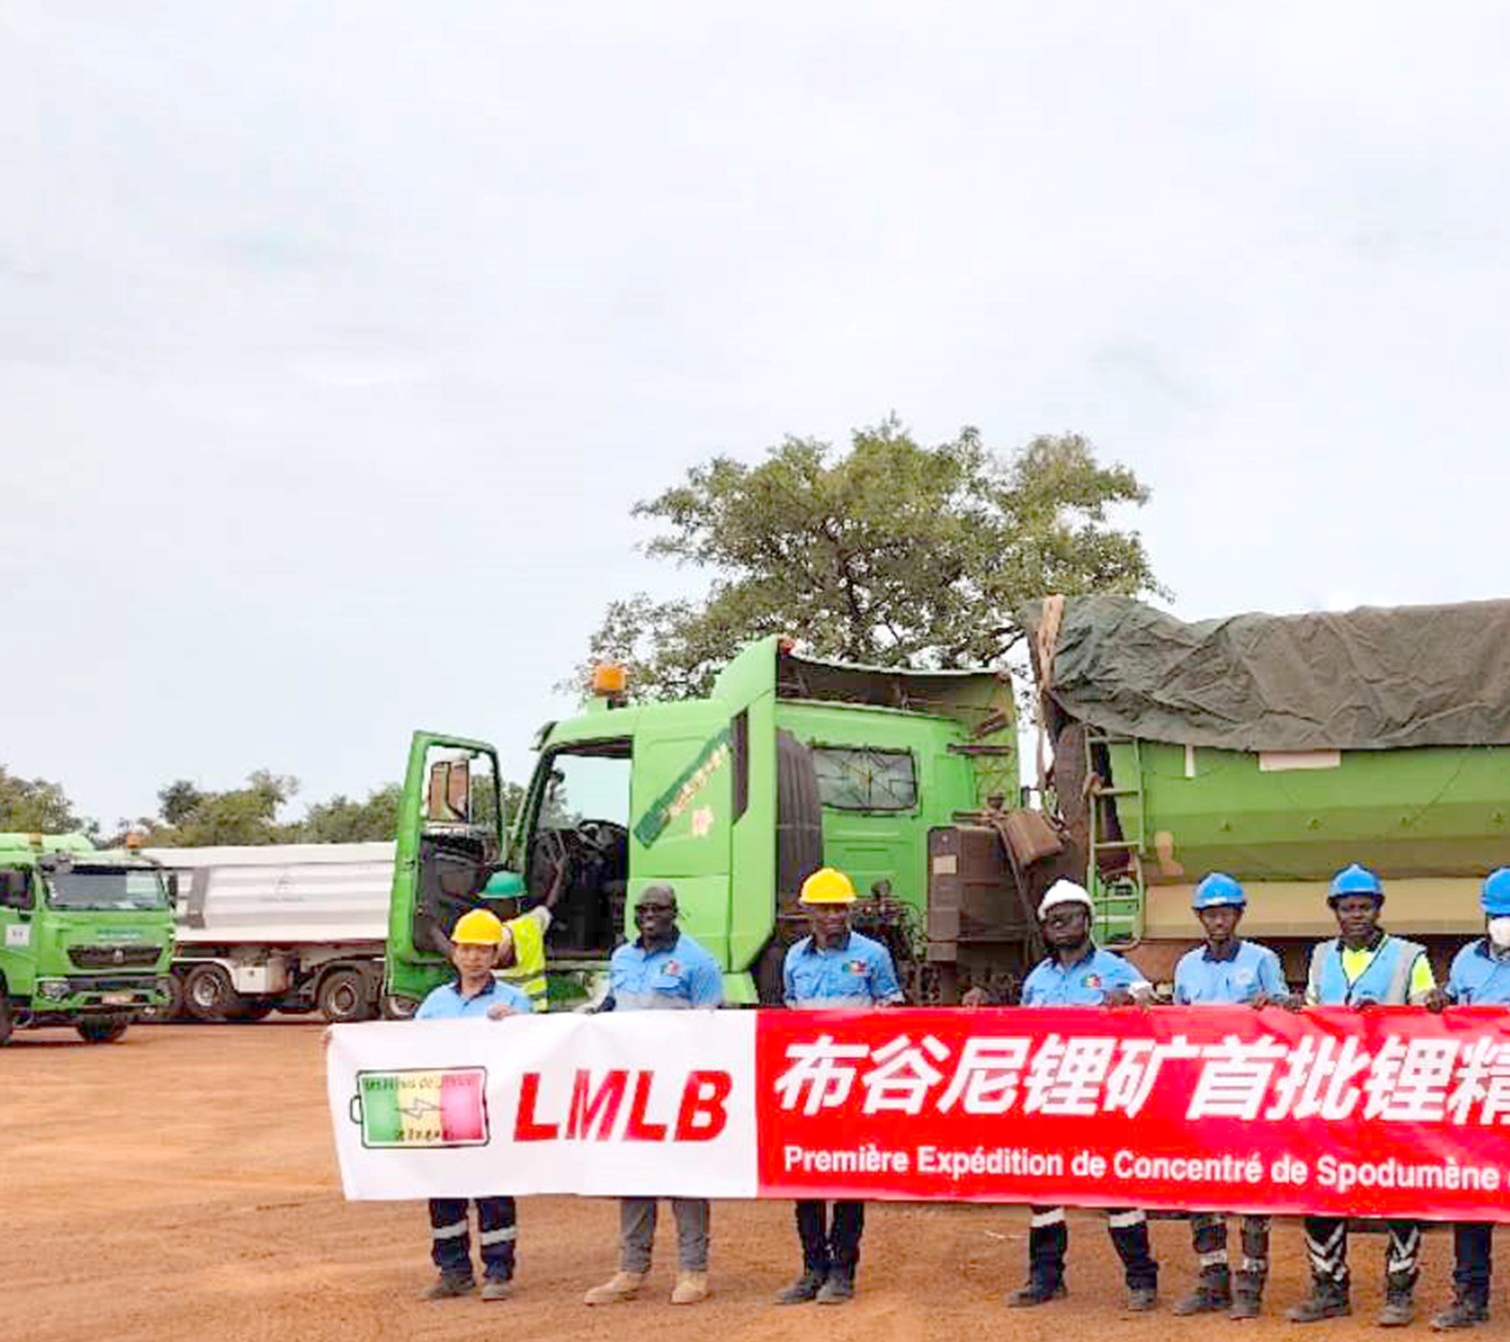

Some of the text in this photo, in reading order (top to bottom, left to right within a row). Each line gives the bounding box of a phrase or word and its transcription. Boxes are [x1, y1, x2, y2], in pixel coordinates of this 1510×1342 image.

[514, 1069, 733, 1142] LMLB
[784, 1144, 909, 1175] Première
[917, 1144, 1063, 1181] Expédition
[1071, 1151, 1107, 1177] de
[1113, 1149, 1263, 1183] Concentré
[1271, 1157, 1308, 1183] de
[1317, 1156, 1500, 1191] Spodumène
